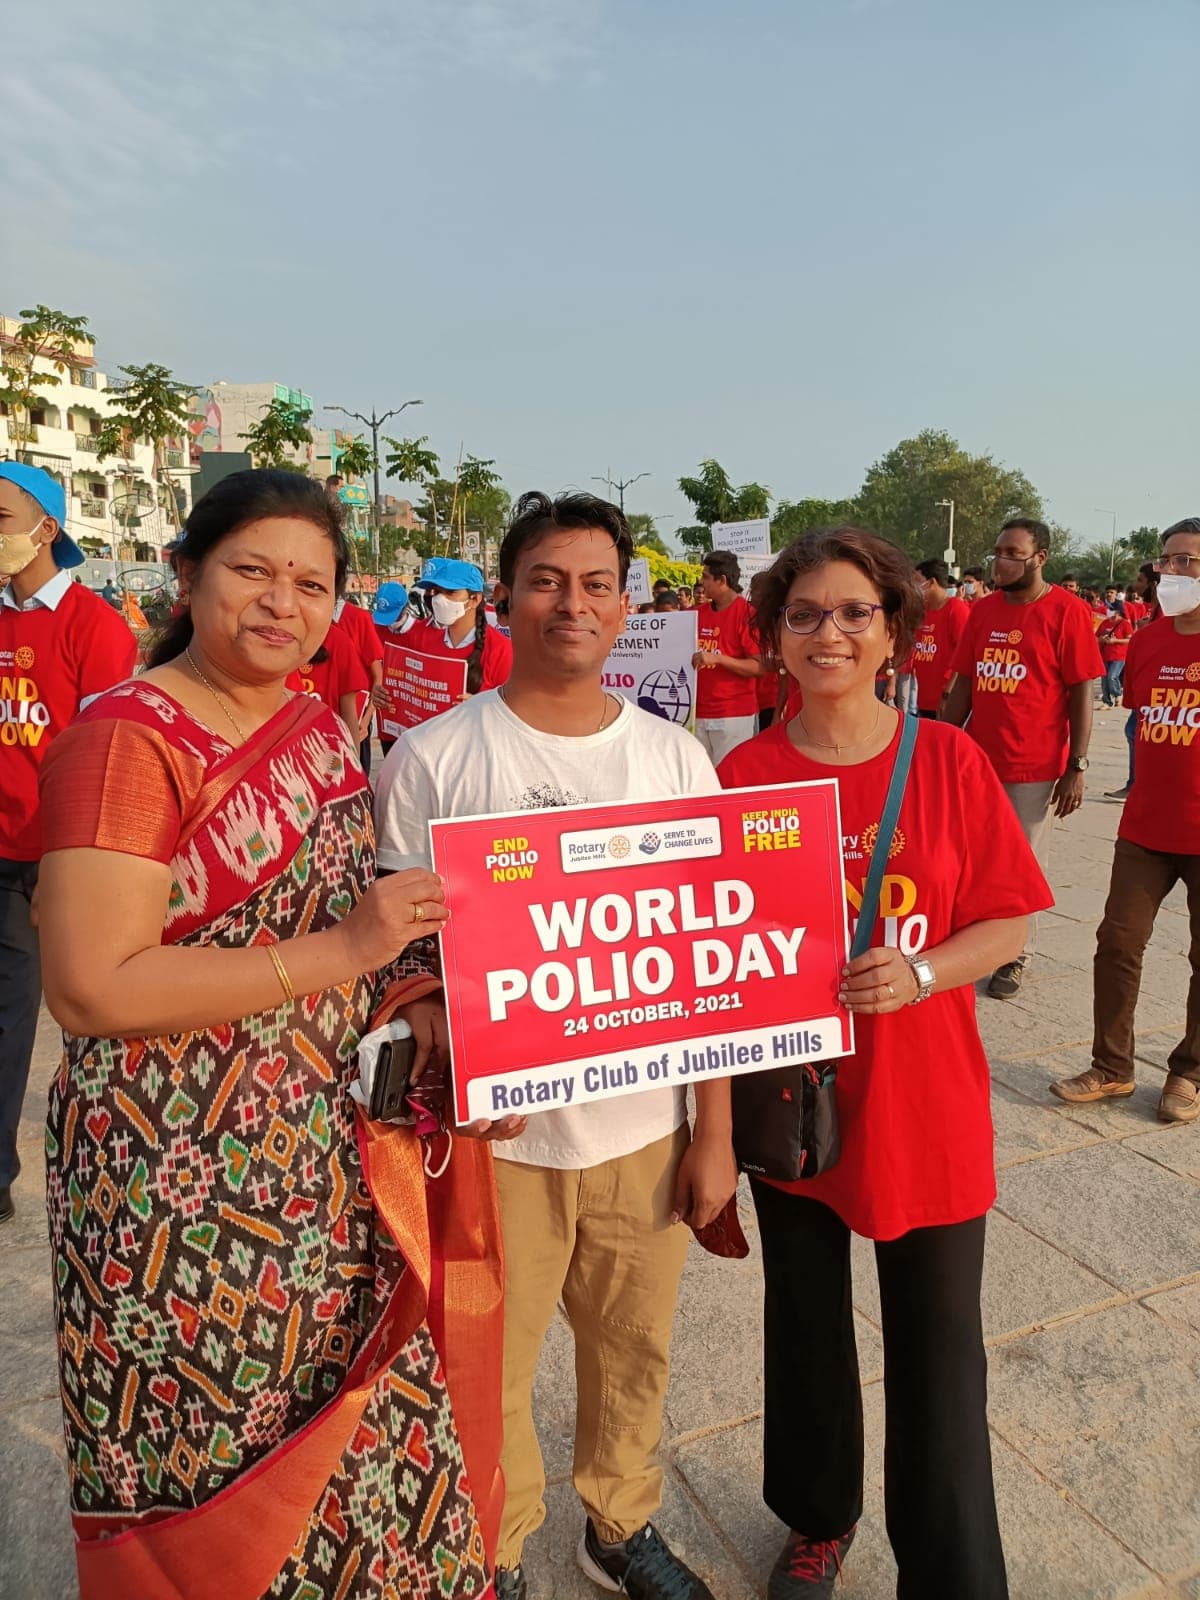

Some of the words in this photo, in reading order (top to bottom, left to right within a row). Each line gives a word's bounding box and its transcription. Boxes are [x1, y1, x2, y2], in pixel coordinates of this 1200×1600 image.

[625, 619, 647, 630] EGE
[650, 618, 667, 630] OF
[982, 647, 1020, 665] END
[600, 671, 636, 688] LIO
[976, 661, 1027, 681] POLIO
[1160, 665, 1186, 675] Rotary
[0, 676, 39, 702] ND
[976, 676, 1021, 694] NOW
[1150, 687, 1200, 709] END
[1140, 705, 1200, 729] POLIO
[0, 721, 46, 747] OW
[1140, 721, 1199, 746] NOW
[742, 810, 769, 821] KEEP
[770, 807, 799, 818] INDIA
[663, 831, 685, 840] SERVE
[686, 829, 696, 838] TO
[743, 815, 800, 836] POLIO
[493, 836, 529, 854] END
[568, 841, 606, 855] Rotary
[664, 838, 693, 849] CHANGE
[694, 836, 714, 847] LIVES
[744, 829, 802, 853] FREE
[842, 834, 859, 848] ry
[485, 850, 539, 870] POLIO
[570, 855, 592, 863] Jubilee
[592, 853, 606, 861] Hills
[492, 865, 534, 883] NOW
[527, 878, 756, 954] WORLD
[486, 945, 675, 1023] POLIO
[691, 926, 807, 989] DAY
[564, 1016, 590, 1036] 24
[593, 1001, 691, 1030] OCTOBER,
[694, 991, 743, 1014] 2021
[490, 1077, 575, 1111] Rotary
[583, 1060, 639, 1093] Club
[646, 1053, 670, 1081] of
[677, 1043, 764, 1075] Jubilee
[771, 1031, 823, 1060] Hills
